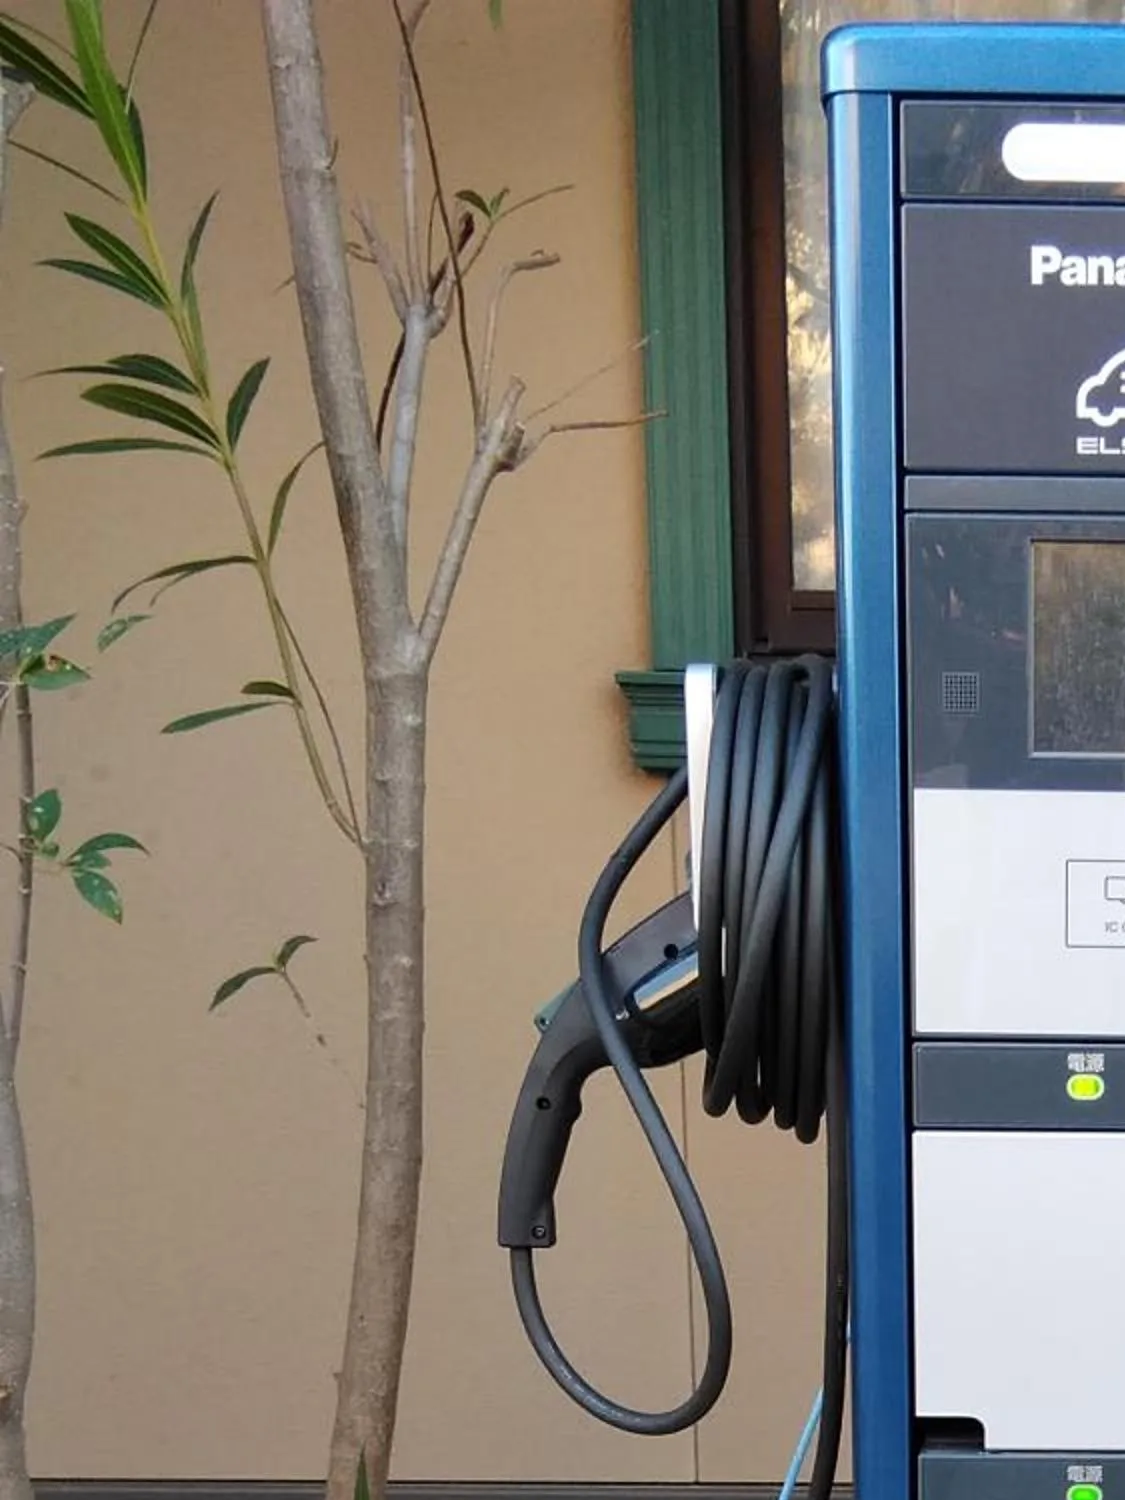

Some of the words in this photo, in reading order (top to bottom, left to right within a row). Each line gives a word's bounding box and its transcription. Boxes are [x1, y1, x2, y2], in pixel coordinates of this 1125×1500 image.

[1105, 922, 1118, 932] IC
[1067, 1053, 1105, 1072] 電源
[1066, 1465, 1103, 1482] 電源
